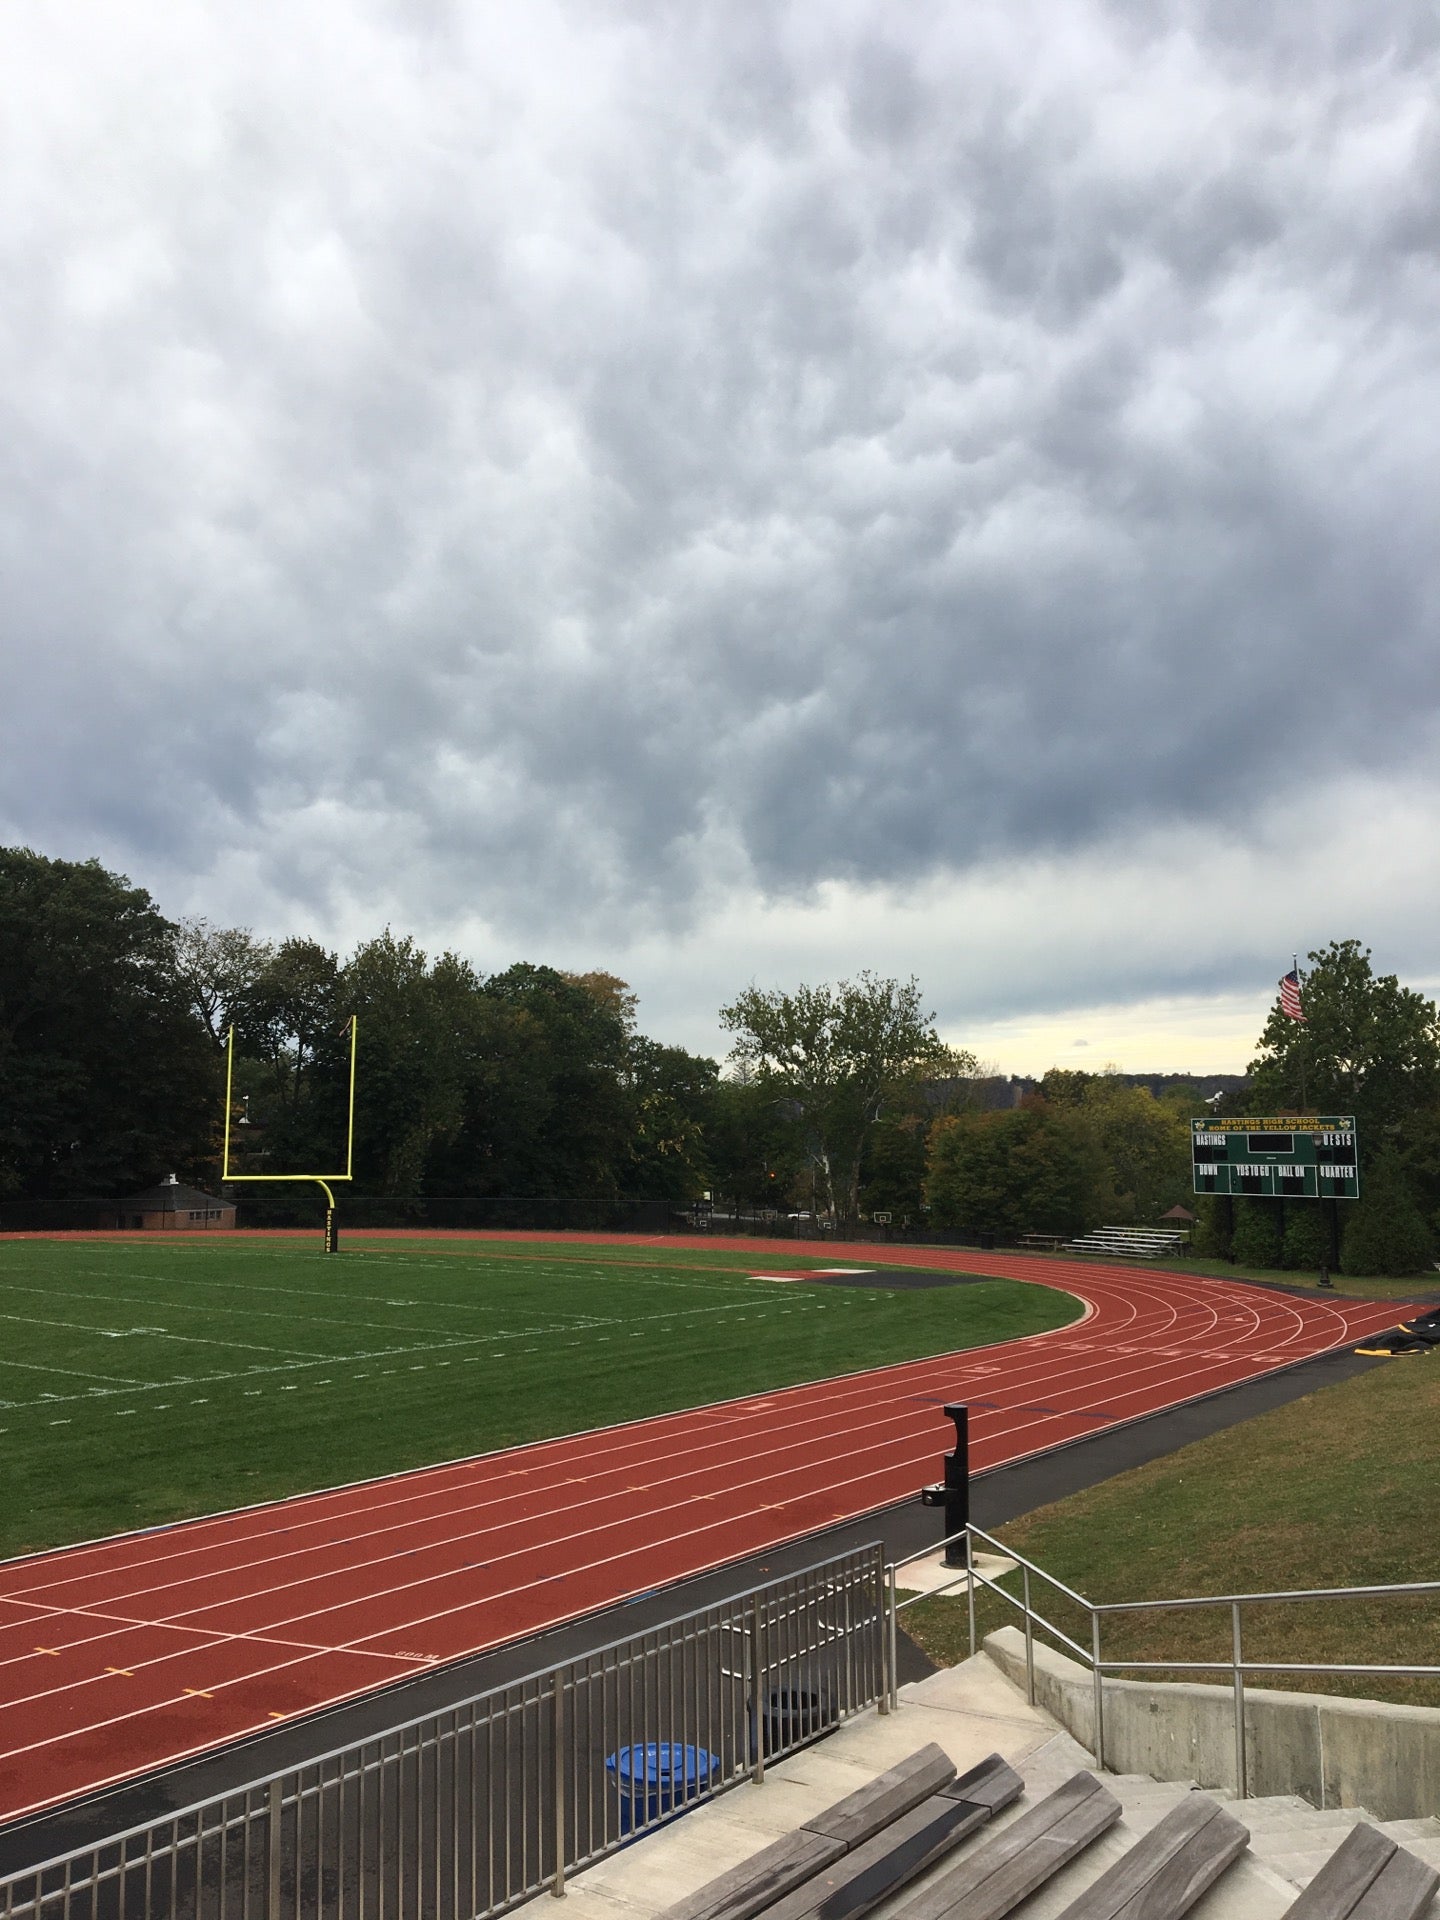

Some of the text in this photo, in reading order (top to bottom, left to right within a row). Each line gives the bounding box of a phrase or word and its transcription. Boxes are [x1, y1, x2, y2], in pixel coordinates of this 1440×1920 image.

[1196, 1134, 1226, 1146] HASTINGS
[1322, 1134, 1352, 1146] UESTS
[1199, 1165, 1218, 1176] DOWN
[1278, 1165, 1305, 1178] BALL ON
[1320, 1166, 1354, 1178] QUARTER
